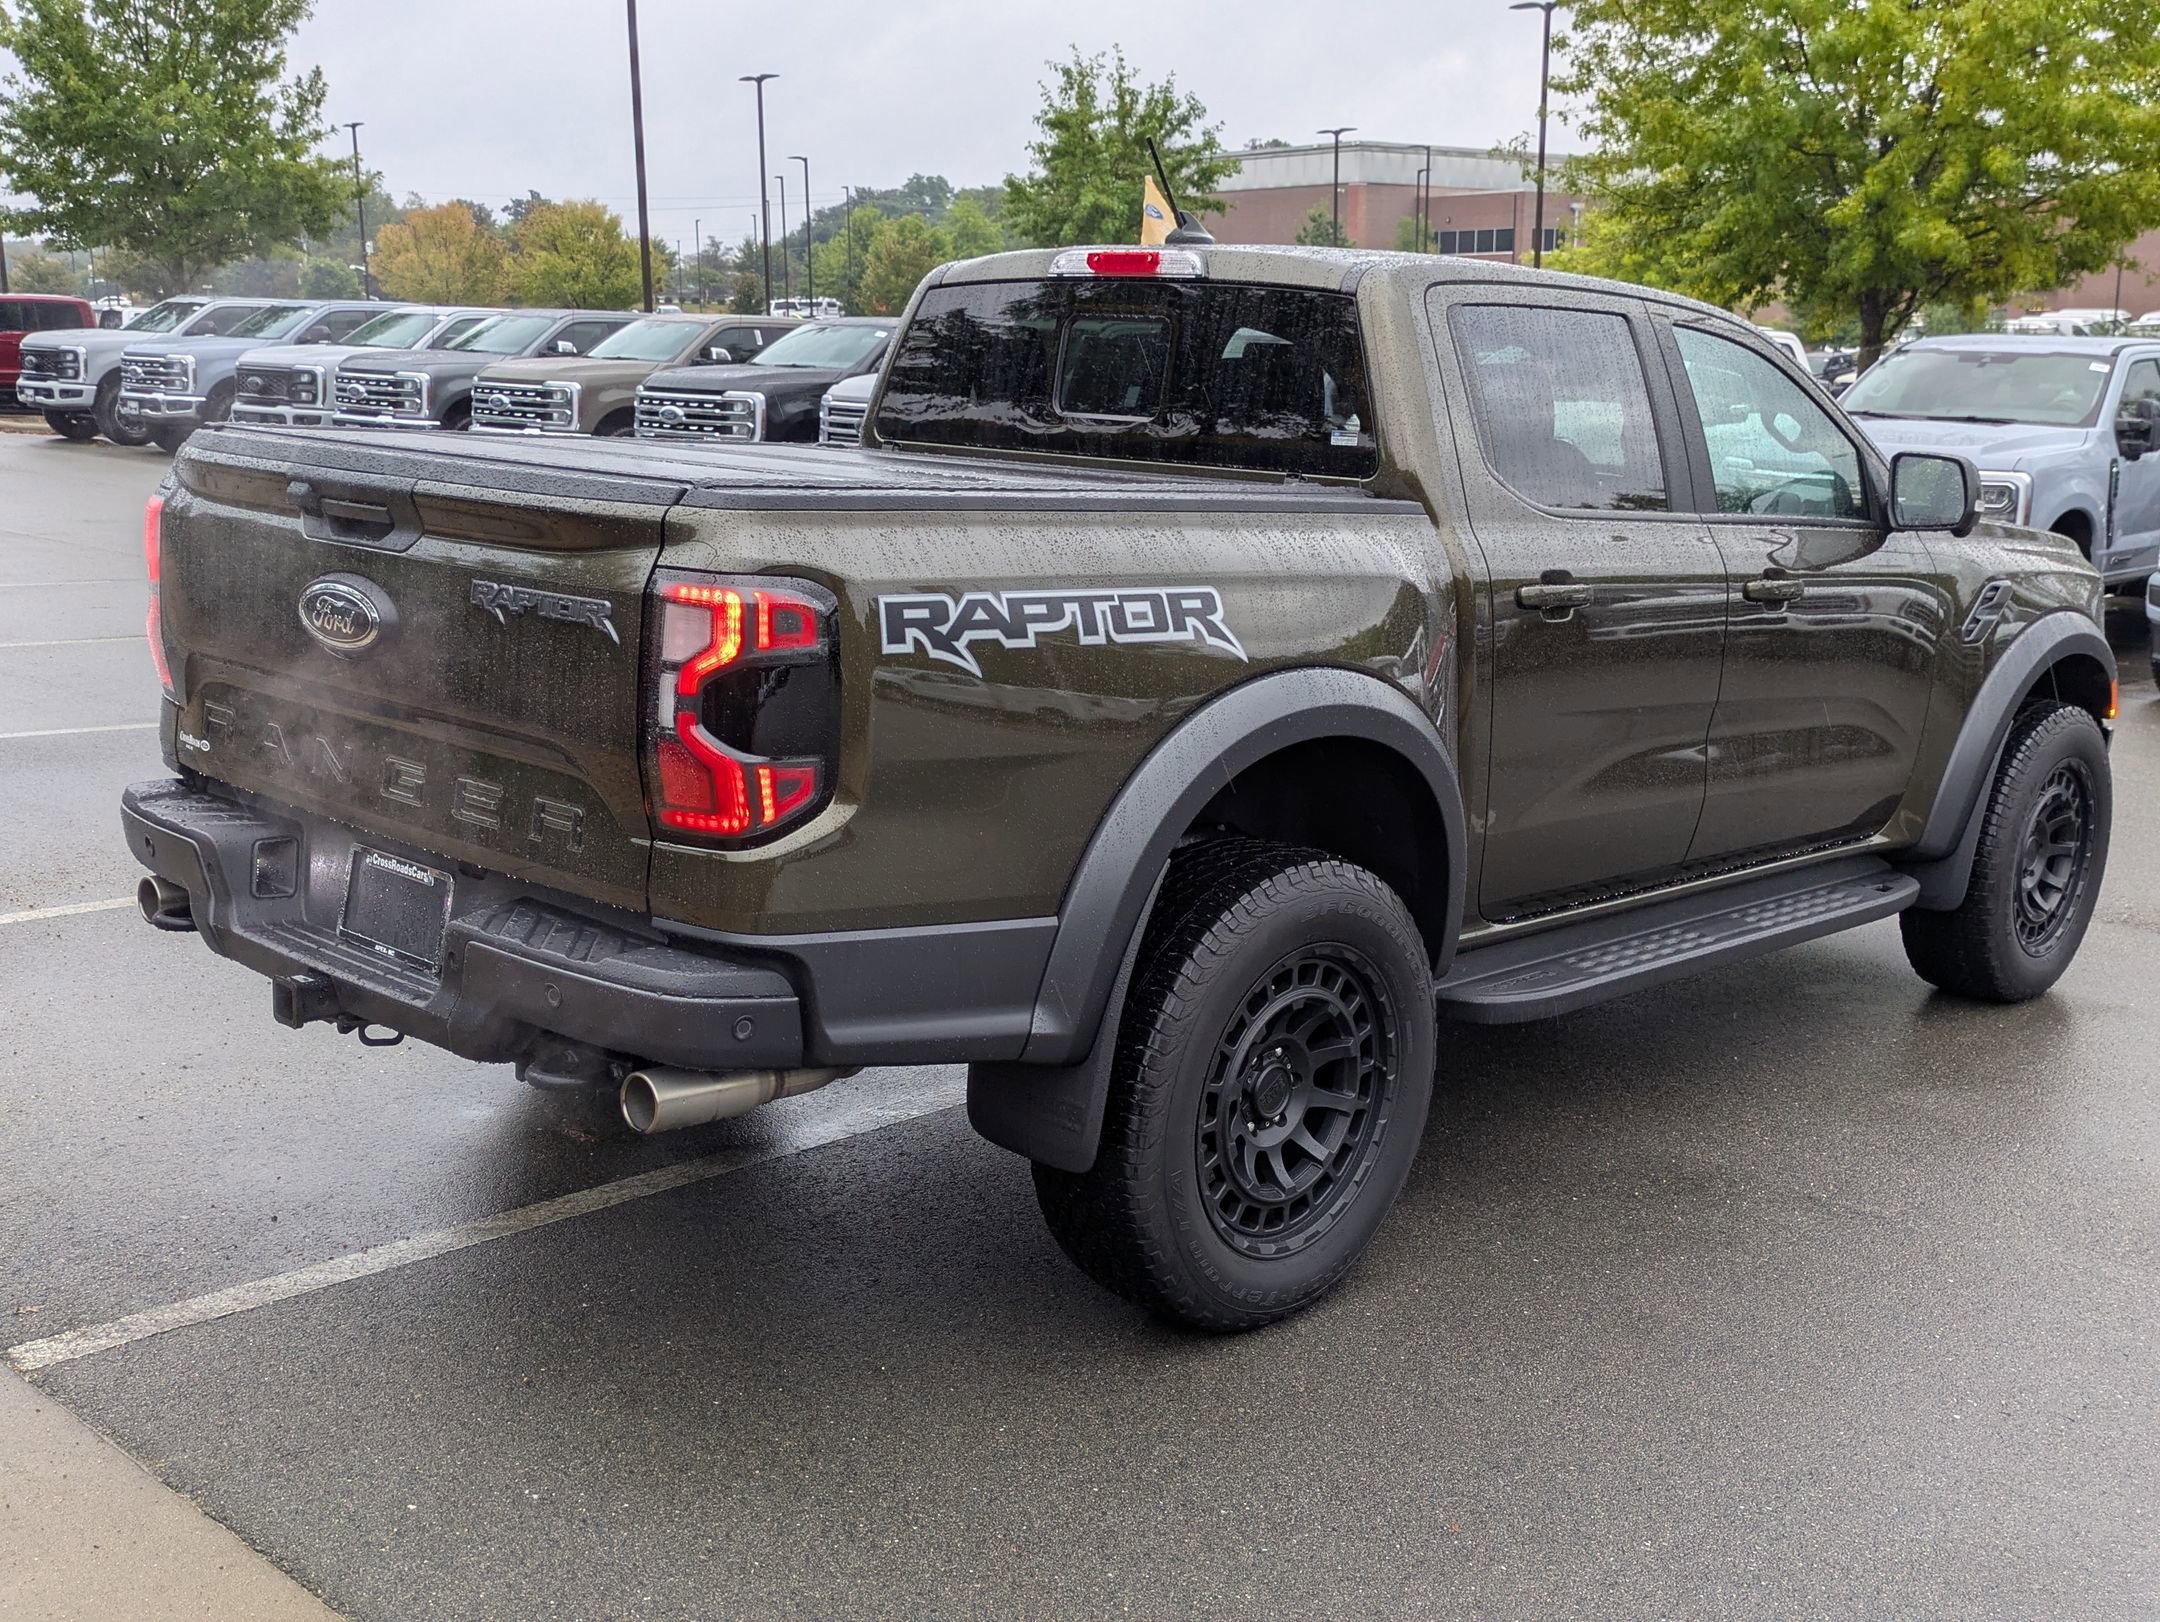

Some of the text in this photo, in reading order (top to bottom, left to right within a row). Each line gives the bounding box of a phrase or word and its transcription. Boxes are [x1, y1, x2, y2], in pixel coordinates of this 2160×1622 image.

[312, 595, 356, 634] Ford
[470, 578, 620, 646] RAPTOR
[877, 585, 1248, 679] RAPTOR
[203, 699, 586, 853] RANGER
